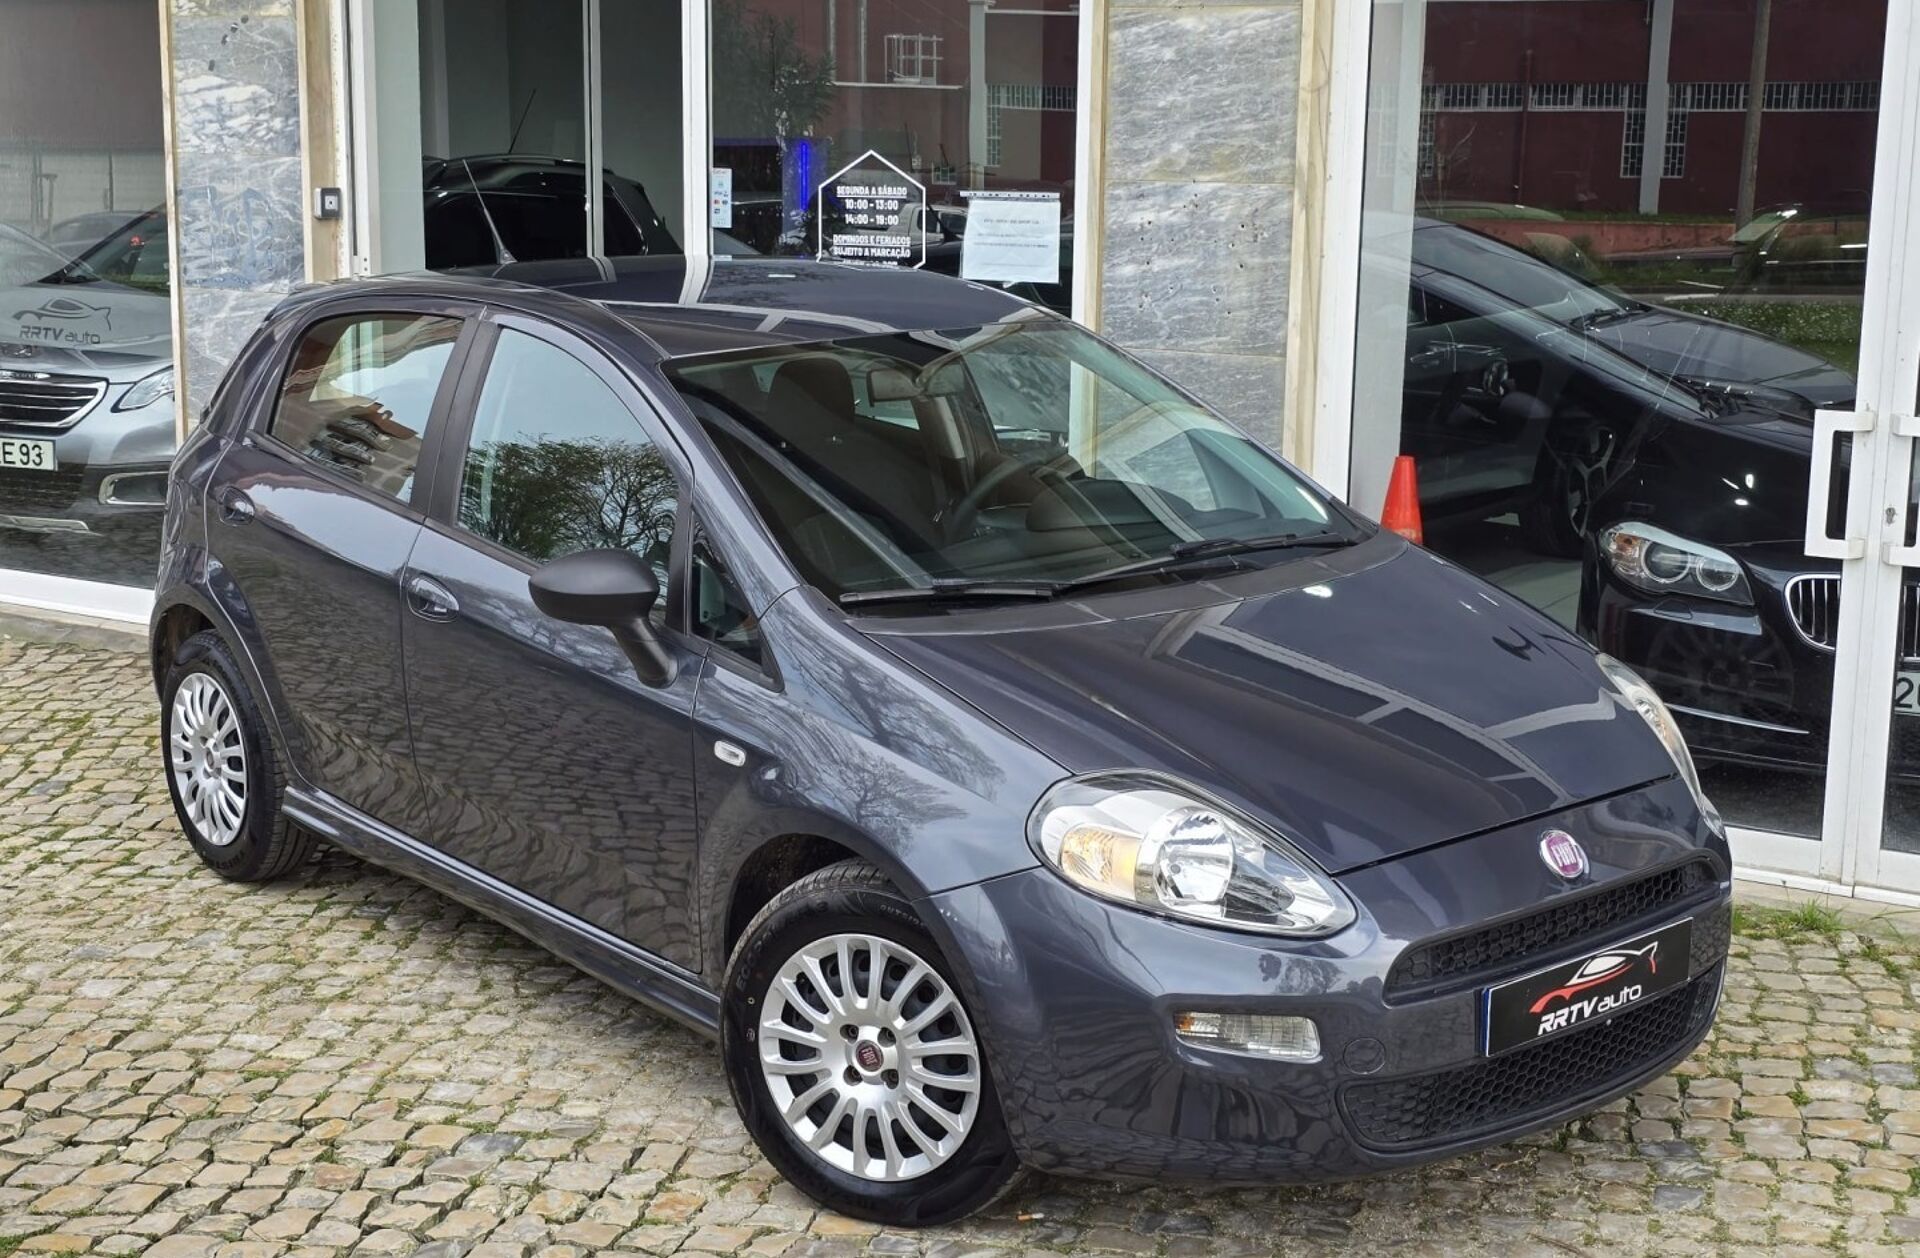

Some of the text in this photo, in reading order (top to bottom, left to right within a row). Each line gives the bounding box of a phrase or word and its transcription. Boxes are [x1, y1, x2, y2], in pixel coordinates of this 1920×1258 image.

[836, 184, 908, 196] SEGUNDA A SÁBADO
[844, 198, 869, 210] 10:00
[875, 199, 899, 211] 13:00
[844, 213, 869, 225] 14:00
[833, 234, 911, 246] DOMINGOS E FERIADOS
[833, 246, 911, 259] SUJEITO A MARCAÇÃO
[20, 326, 101, 345] RRTV auto
[0, 441, 16, 465] E
[1537, 984, 1642, 1036] RRTV auto
